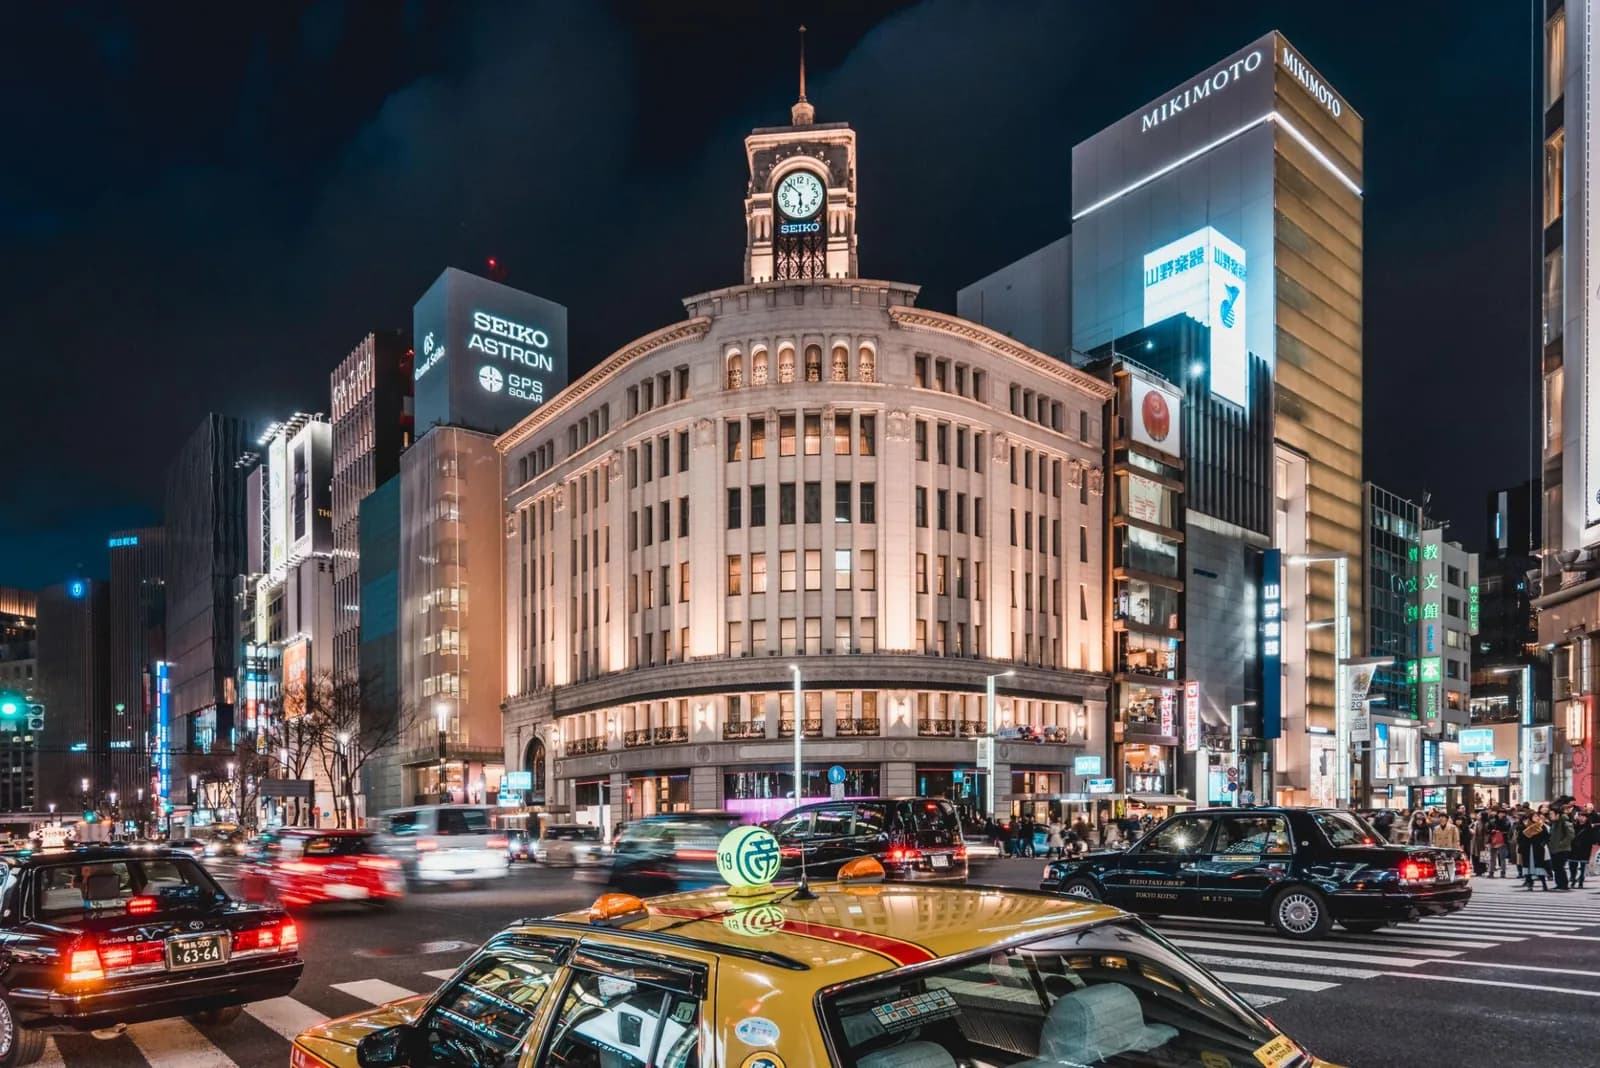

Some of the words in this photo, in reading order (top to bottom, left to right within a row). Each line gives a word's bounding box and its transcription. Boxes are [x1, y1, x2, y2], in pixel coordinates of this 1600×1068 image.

[1141, 51, 1262, 132] MIKIMOTO
[1283, 48, 1341, 118] MIKIMOTO
[781, 223, 820, 233] SEIKO
[474, 312, 548, 348] SEIKO
[468, 334, 553, 372] ASTRON
[508, 374, 543, 393] GPS
[508, 387, 543, 403] SOLAR
[1423, 543, 1439, 619] 教文館
[1423, 661, 1439, 679] 本
[718, 852, 733, 870] 19
[183, 946, 219, 963] 63-64
